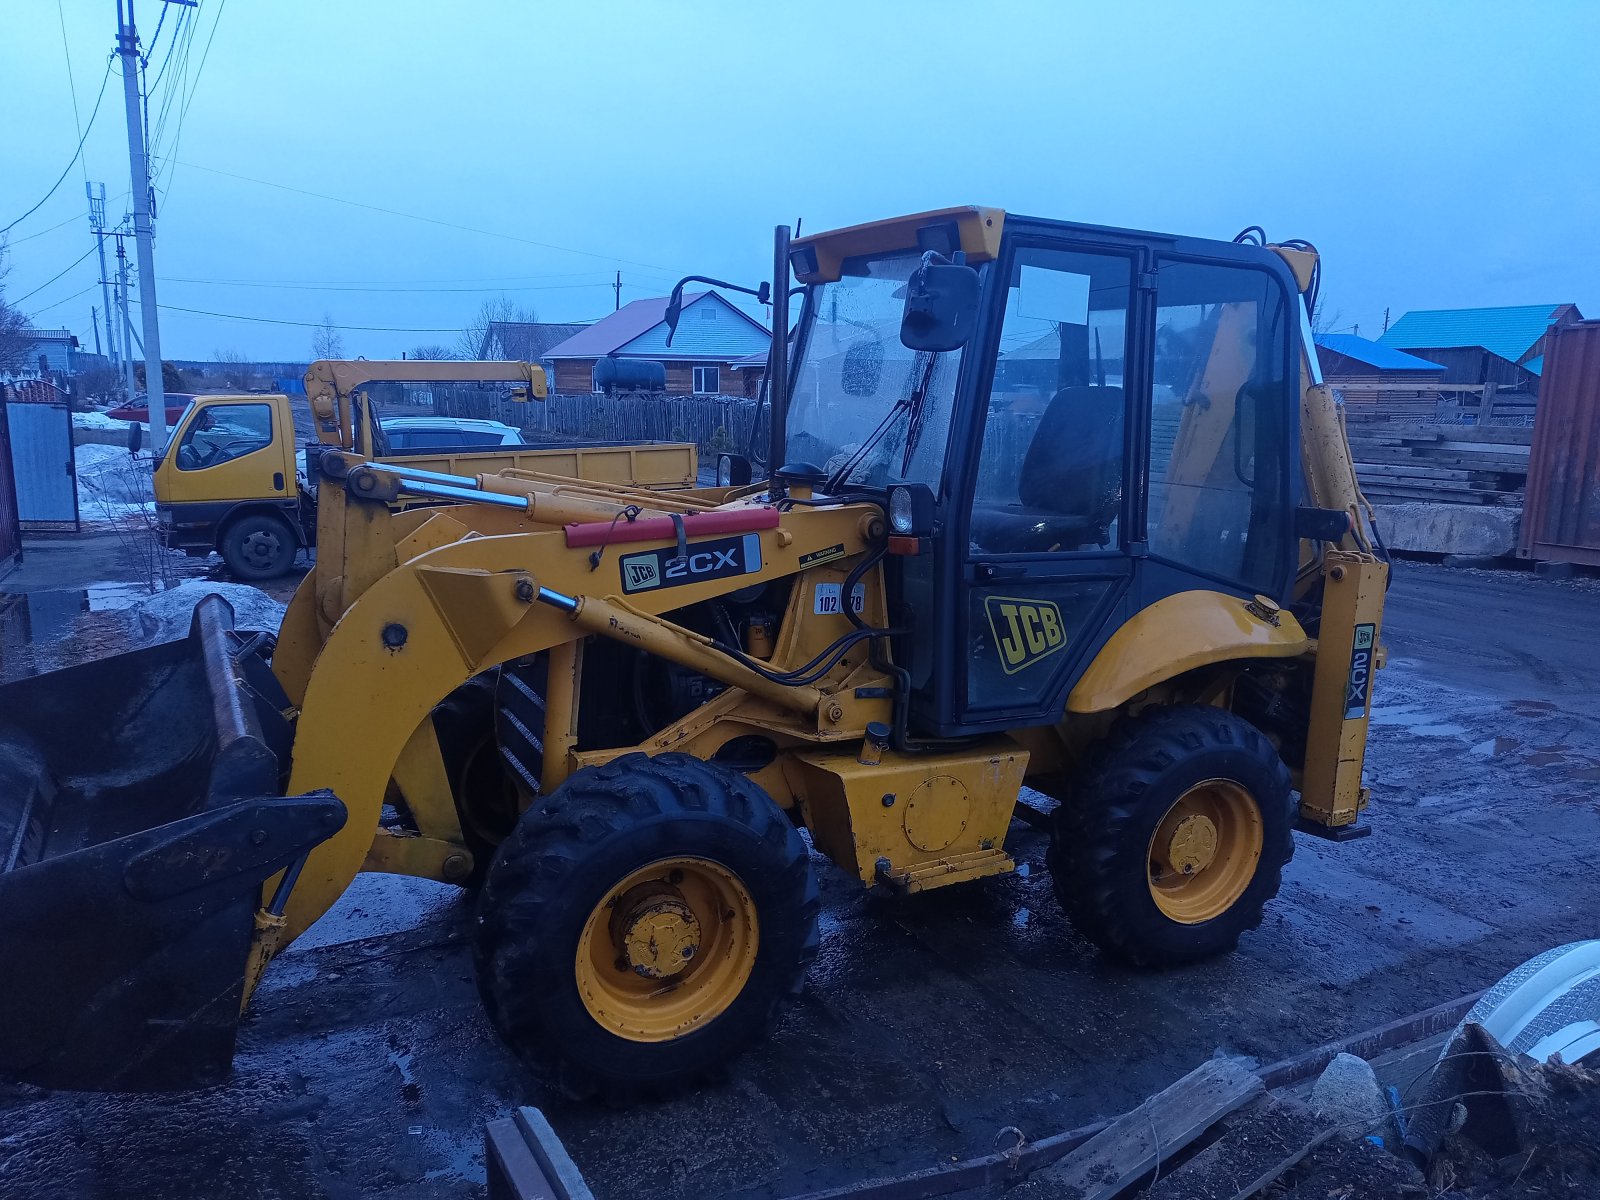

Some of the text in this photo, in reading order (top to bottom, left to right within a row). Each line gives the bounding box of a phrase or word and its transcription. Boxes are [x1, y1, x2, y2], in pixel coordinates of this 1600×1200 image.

[631, 548, 738, 584] JCB 2CX
[820, 596, 861, 612] 102 78
[1000, 604, 1061, 665] JCB
[1348, 652, 1368, 701] 2CX
